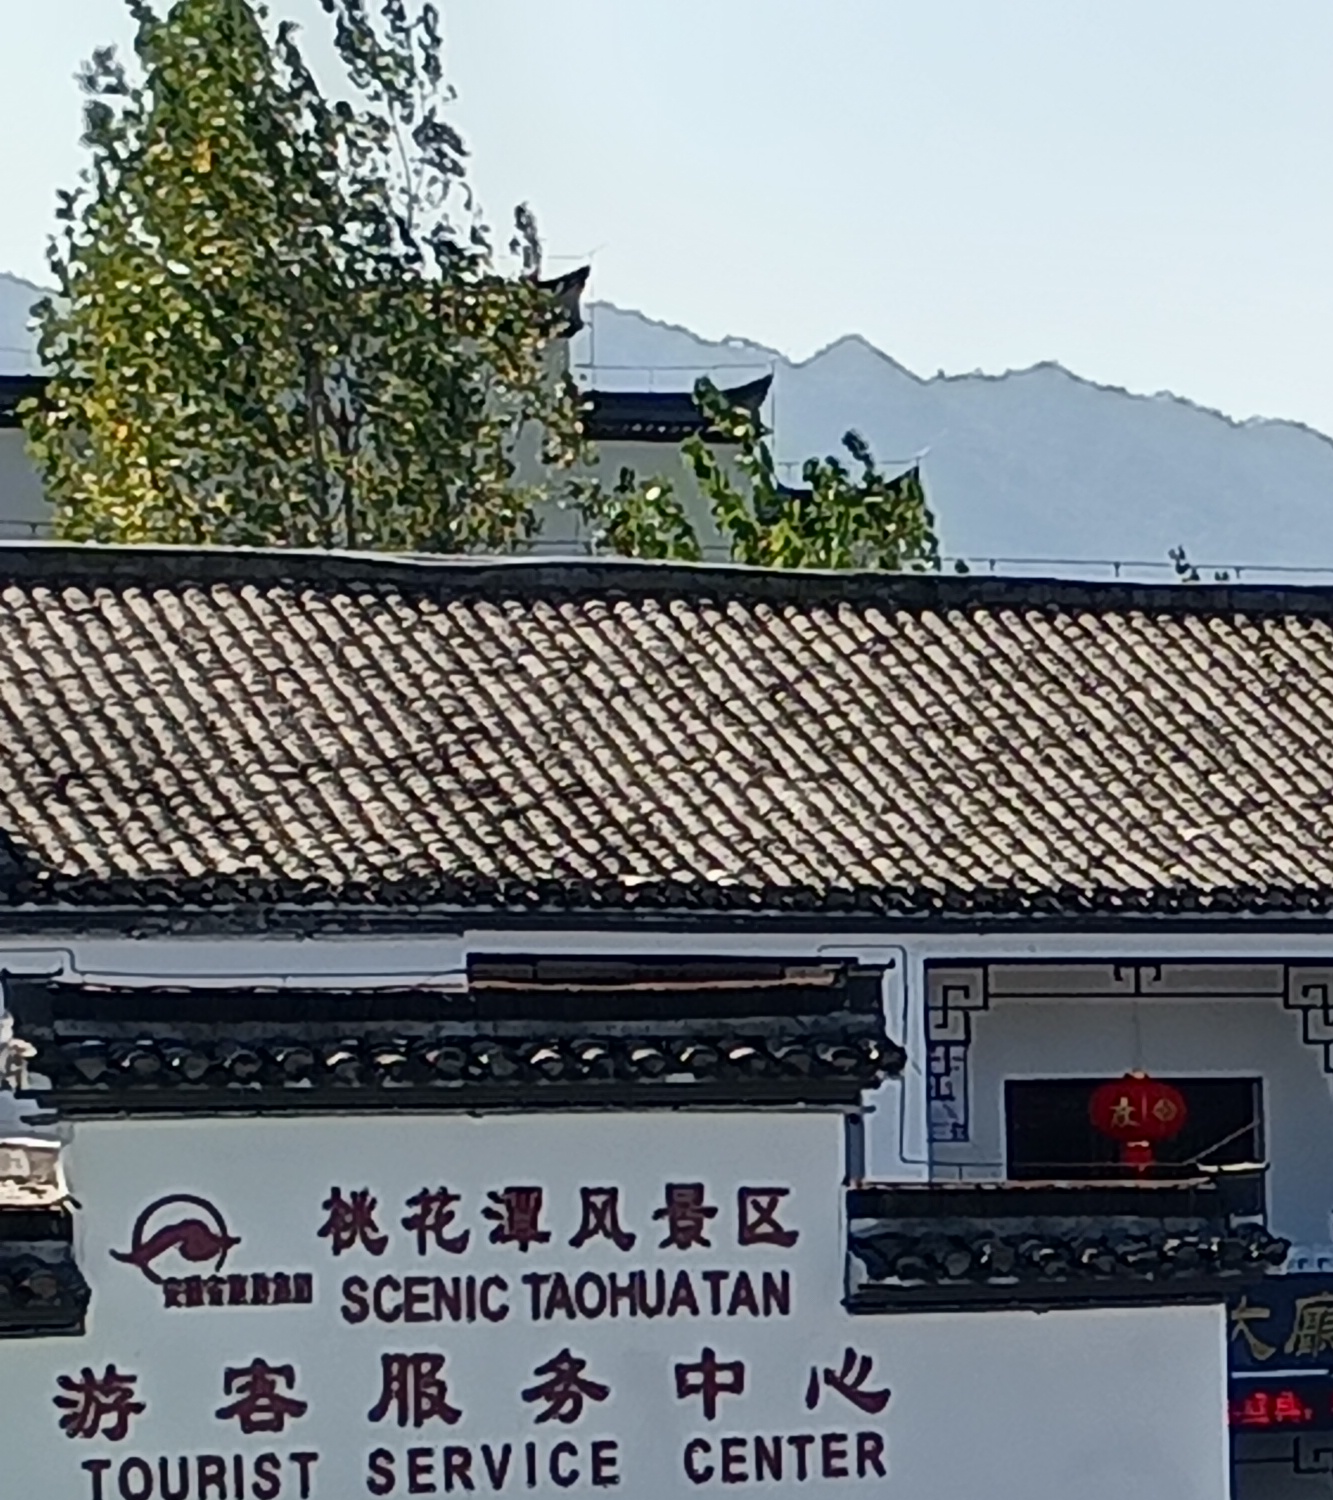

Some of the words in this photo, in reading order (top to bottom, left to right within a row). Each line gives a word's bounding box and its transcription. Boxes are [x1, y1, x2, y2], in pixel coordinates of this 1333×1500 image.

[317, 1182, 799, 1256] 桃花潭风景区
[341, 1275, 509, 1324] SCENIC
[528, 1269, 790, 1321] TAOHUATAN
[52, 1347, 891, 1443] 游客服务中心
[366, 1440, 620, 1496] SERVICE
[684, 1431, 886, 1485] CENTER
